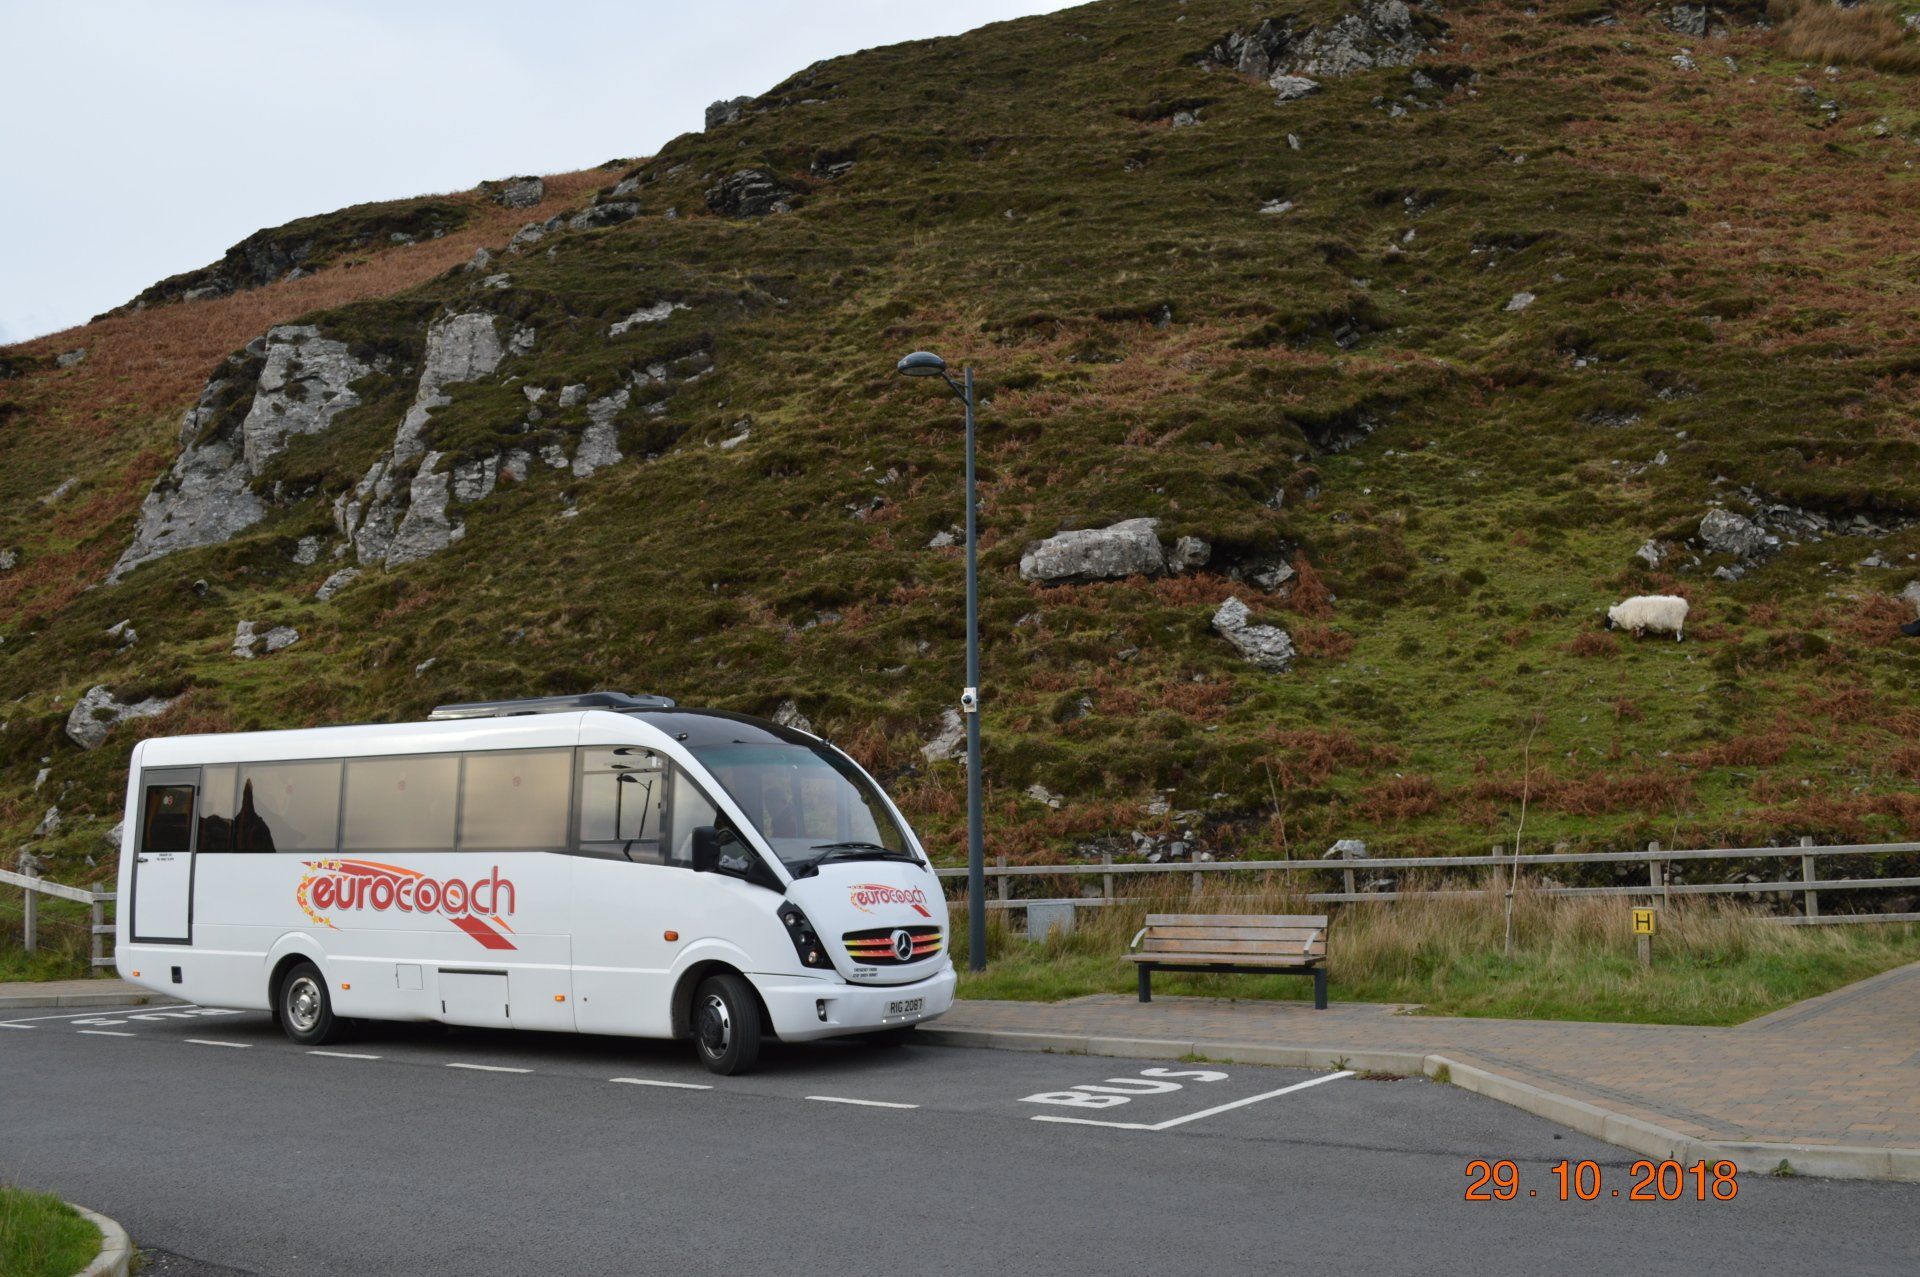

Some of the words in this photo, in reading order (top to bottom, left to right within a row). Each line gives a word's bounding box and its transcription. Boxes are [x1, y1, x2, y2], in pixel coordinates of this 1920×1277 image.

[312, 865, 515, 915] eurocoach
[857, 885, 927, 905] eurocoach
[1635, 912, 1651, 931] H
[890, 1001, 903, 1014] RIG
[904, 998, 923, 1012] 2087
[1017, 1067, 1229, 1108] BUS
